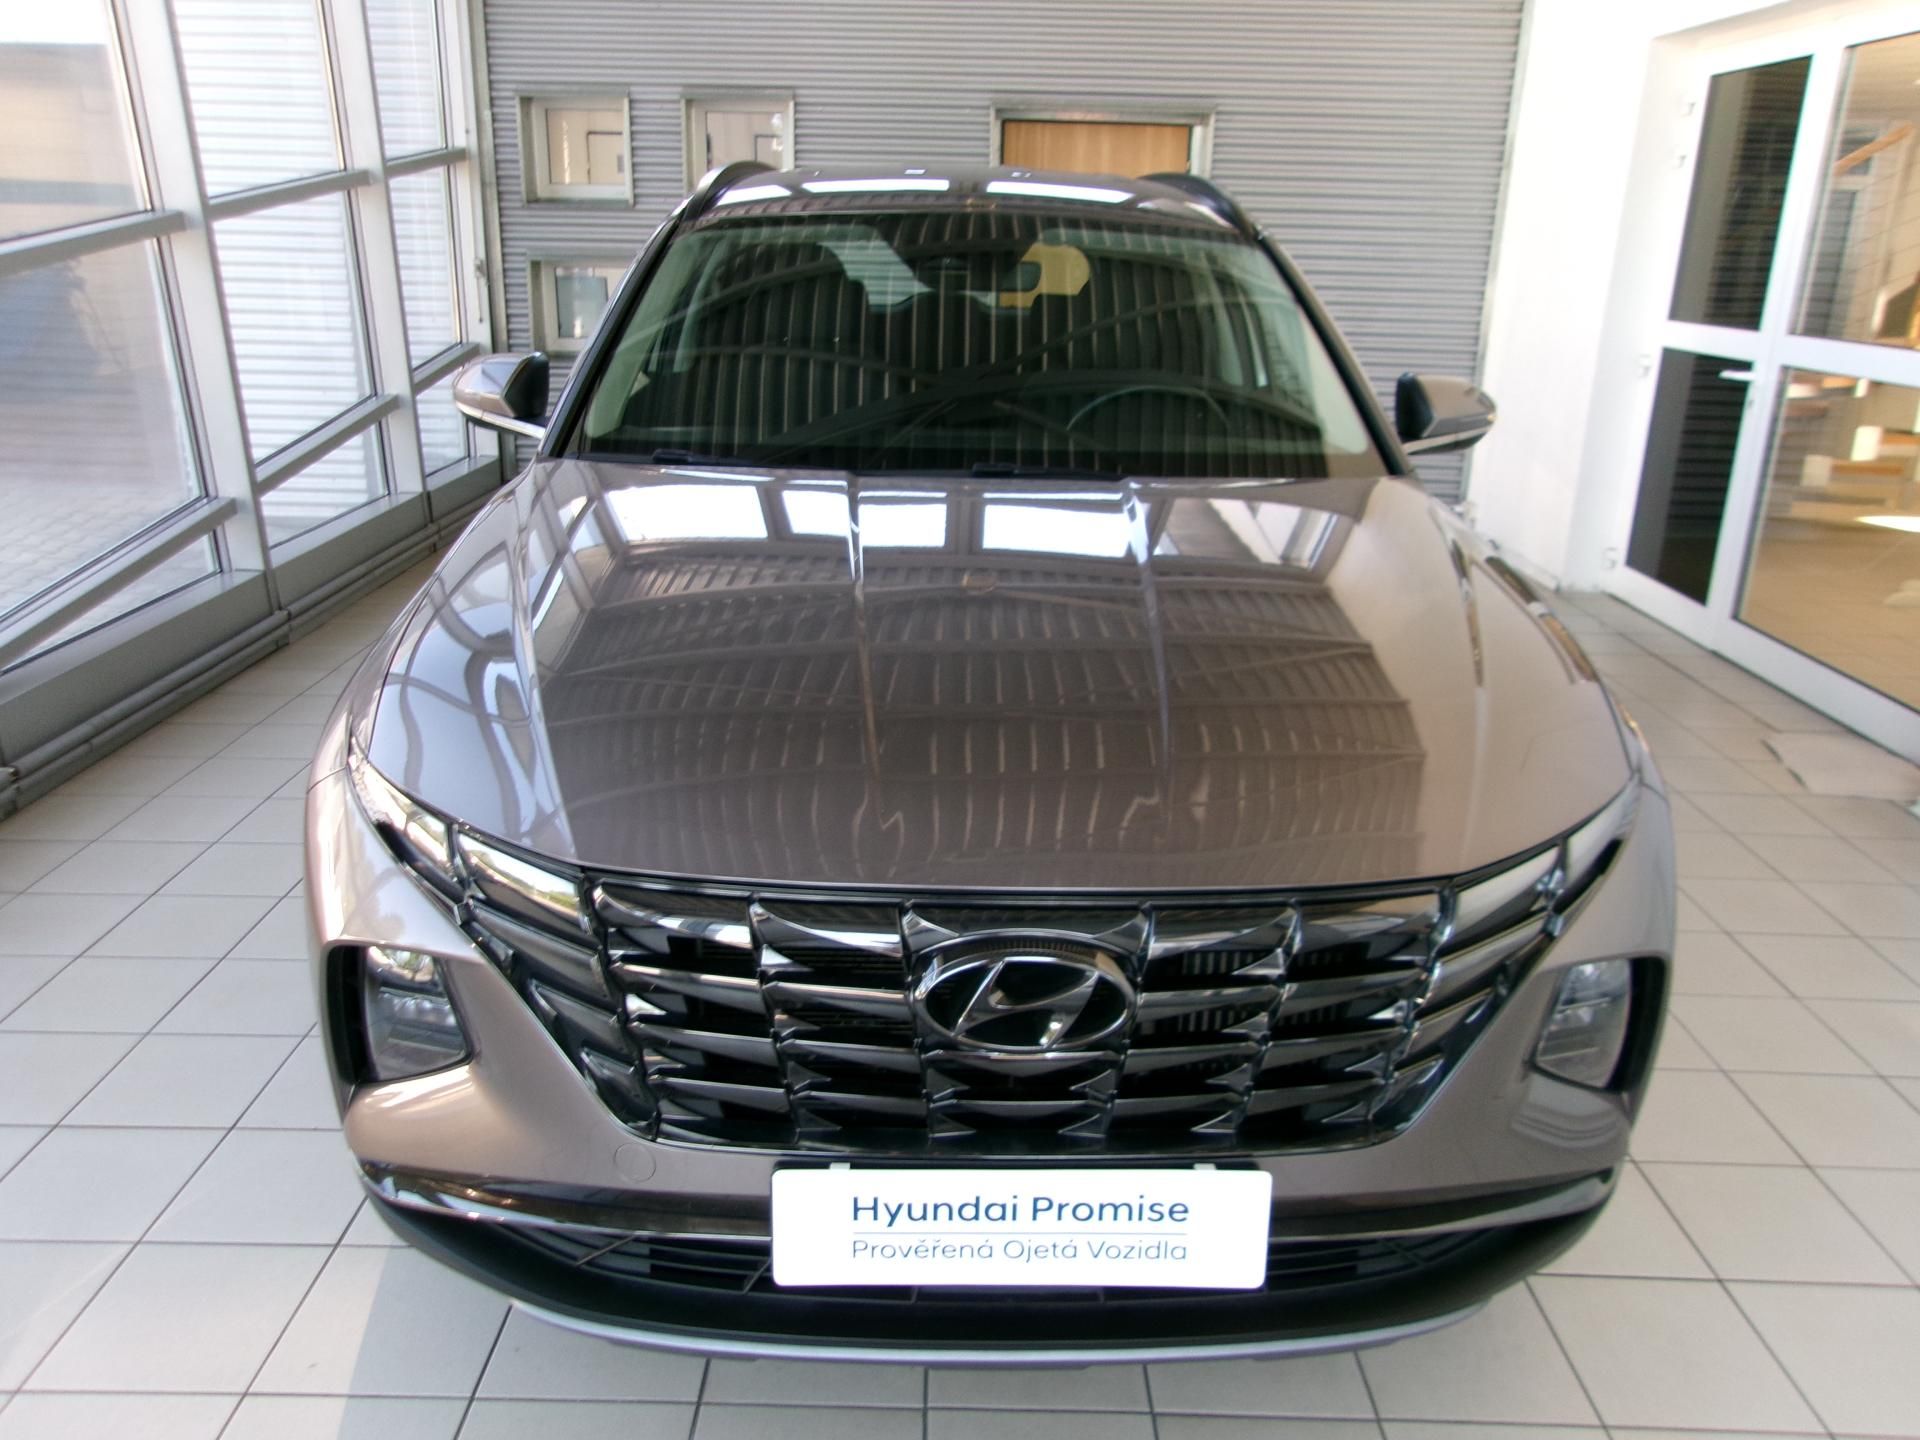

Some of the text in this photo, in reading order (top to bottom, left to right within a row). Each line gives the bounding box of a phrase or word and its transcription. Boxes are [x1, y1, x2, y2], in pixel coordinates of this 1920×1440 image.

[853, 1195, 1190, 1226] Hyundai Promise
[852, 1239, 1187, 1263] Prověřená Ojetá Vozidla
